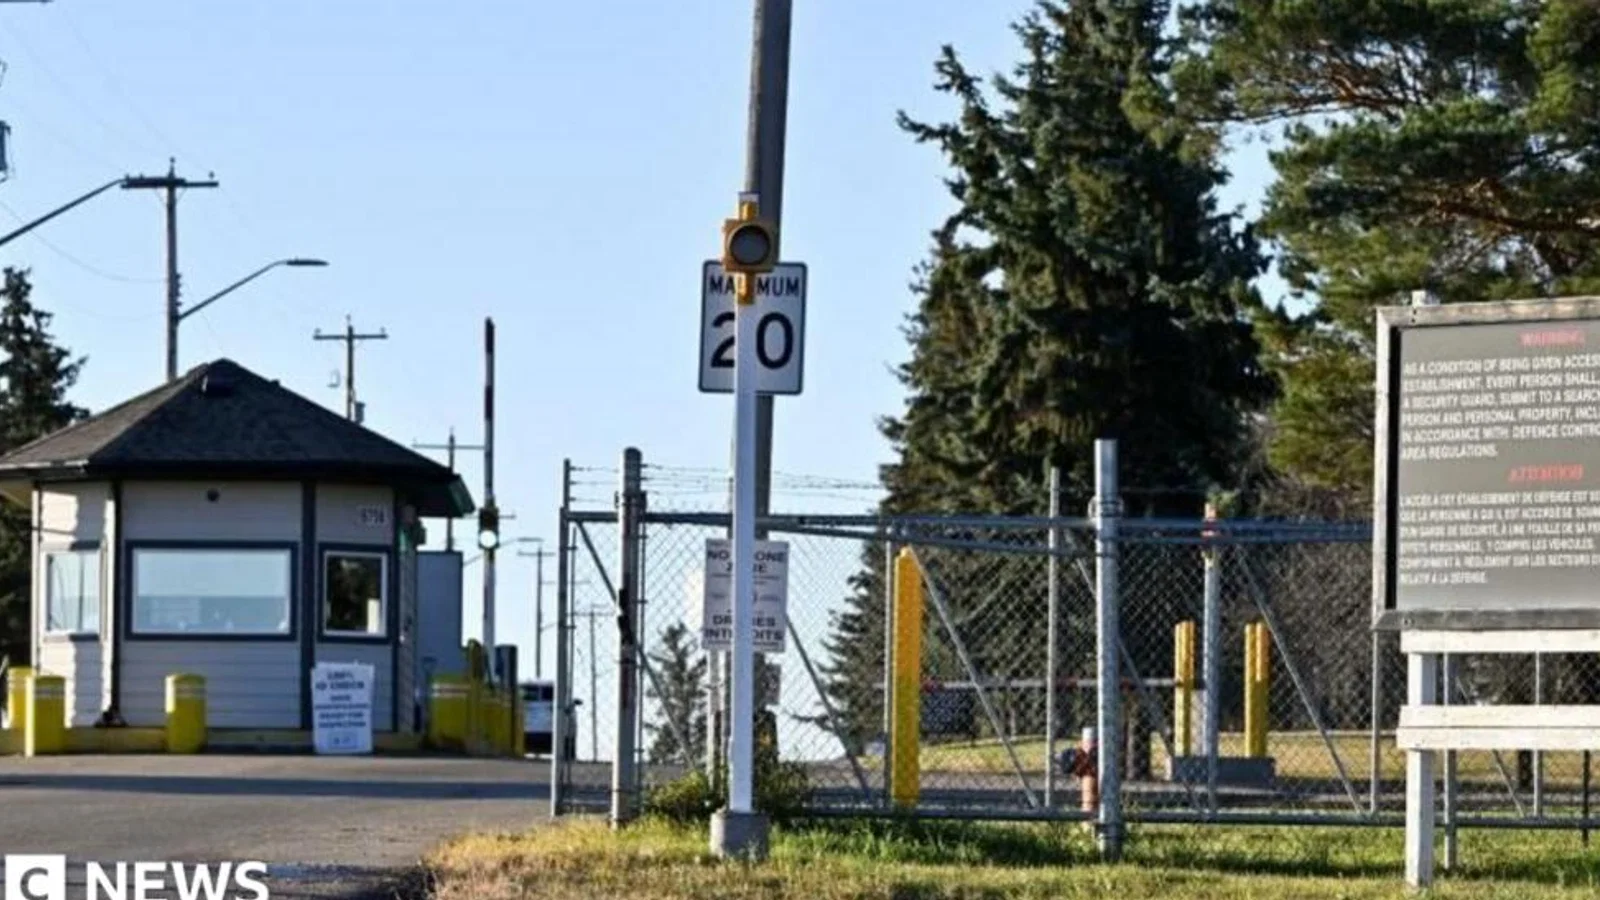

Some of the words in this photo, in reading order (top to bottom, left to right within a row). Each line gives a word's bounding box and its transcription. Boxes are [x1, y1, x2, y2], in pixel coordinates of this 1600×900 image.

[710, 276, 799, 297] MAMUM
[711, 311, 794, 370] 20
[1427, 359, 1482, 374] CONDITION
[1483, 358, 1497, 372] OF
[1499, 357, 1530, 372] BEING
[1532, 355, 1561, 370] GIVEN
[1485, 374, 1517, 389] EVERY
[1520, 373, 1563, 388] PERSON
[1411, 394, 1458, 410] SECURITY
[1499, 390, 1537, 405] SUBMIT
[1539, 390, 1552, 403] TO
[1554, 389, 1561, 402] A
[1402, 411, 1441, 427] PERSON
[1443, 410, 1463, 425] AND
[1465, 409, 1516, 425] PERSONAL
[1402, 429, 1412, 443] IN
[1414, 427, 1480, 442] ACCORDANCE
[1512, 424, 1559, 439] DEFENCE
[1402, 446, 1426, 461] AREA
